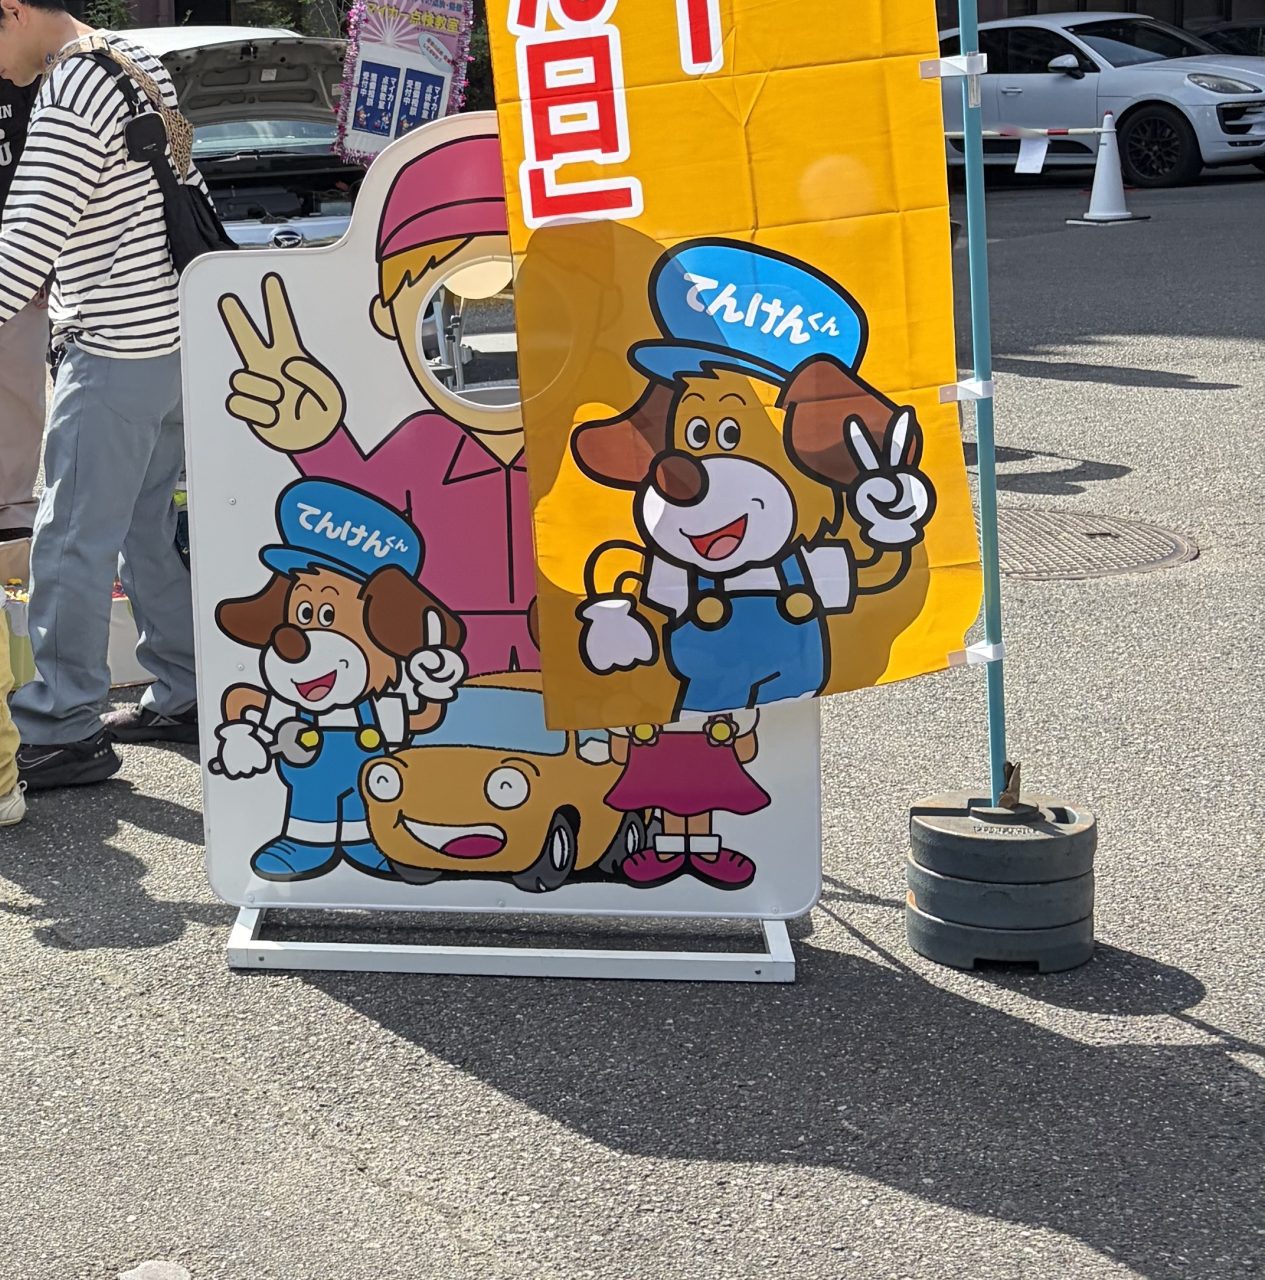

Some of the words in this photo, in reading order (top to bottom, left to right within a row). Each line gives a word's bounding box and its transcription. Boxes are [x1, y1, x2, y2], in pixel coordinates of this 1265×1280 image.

[683, 272, 840, 345] てんけんくん
[294, 502, 409, 558] てんけんくん
